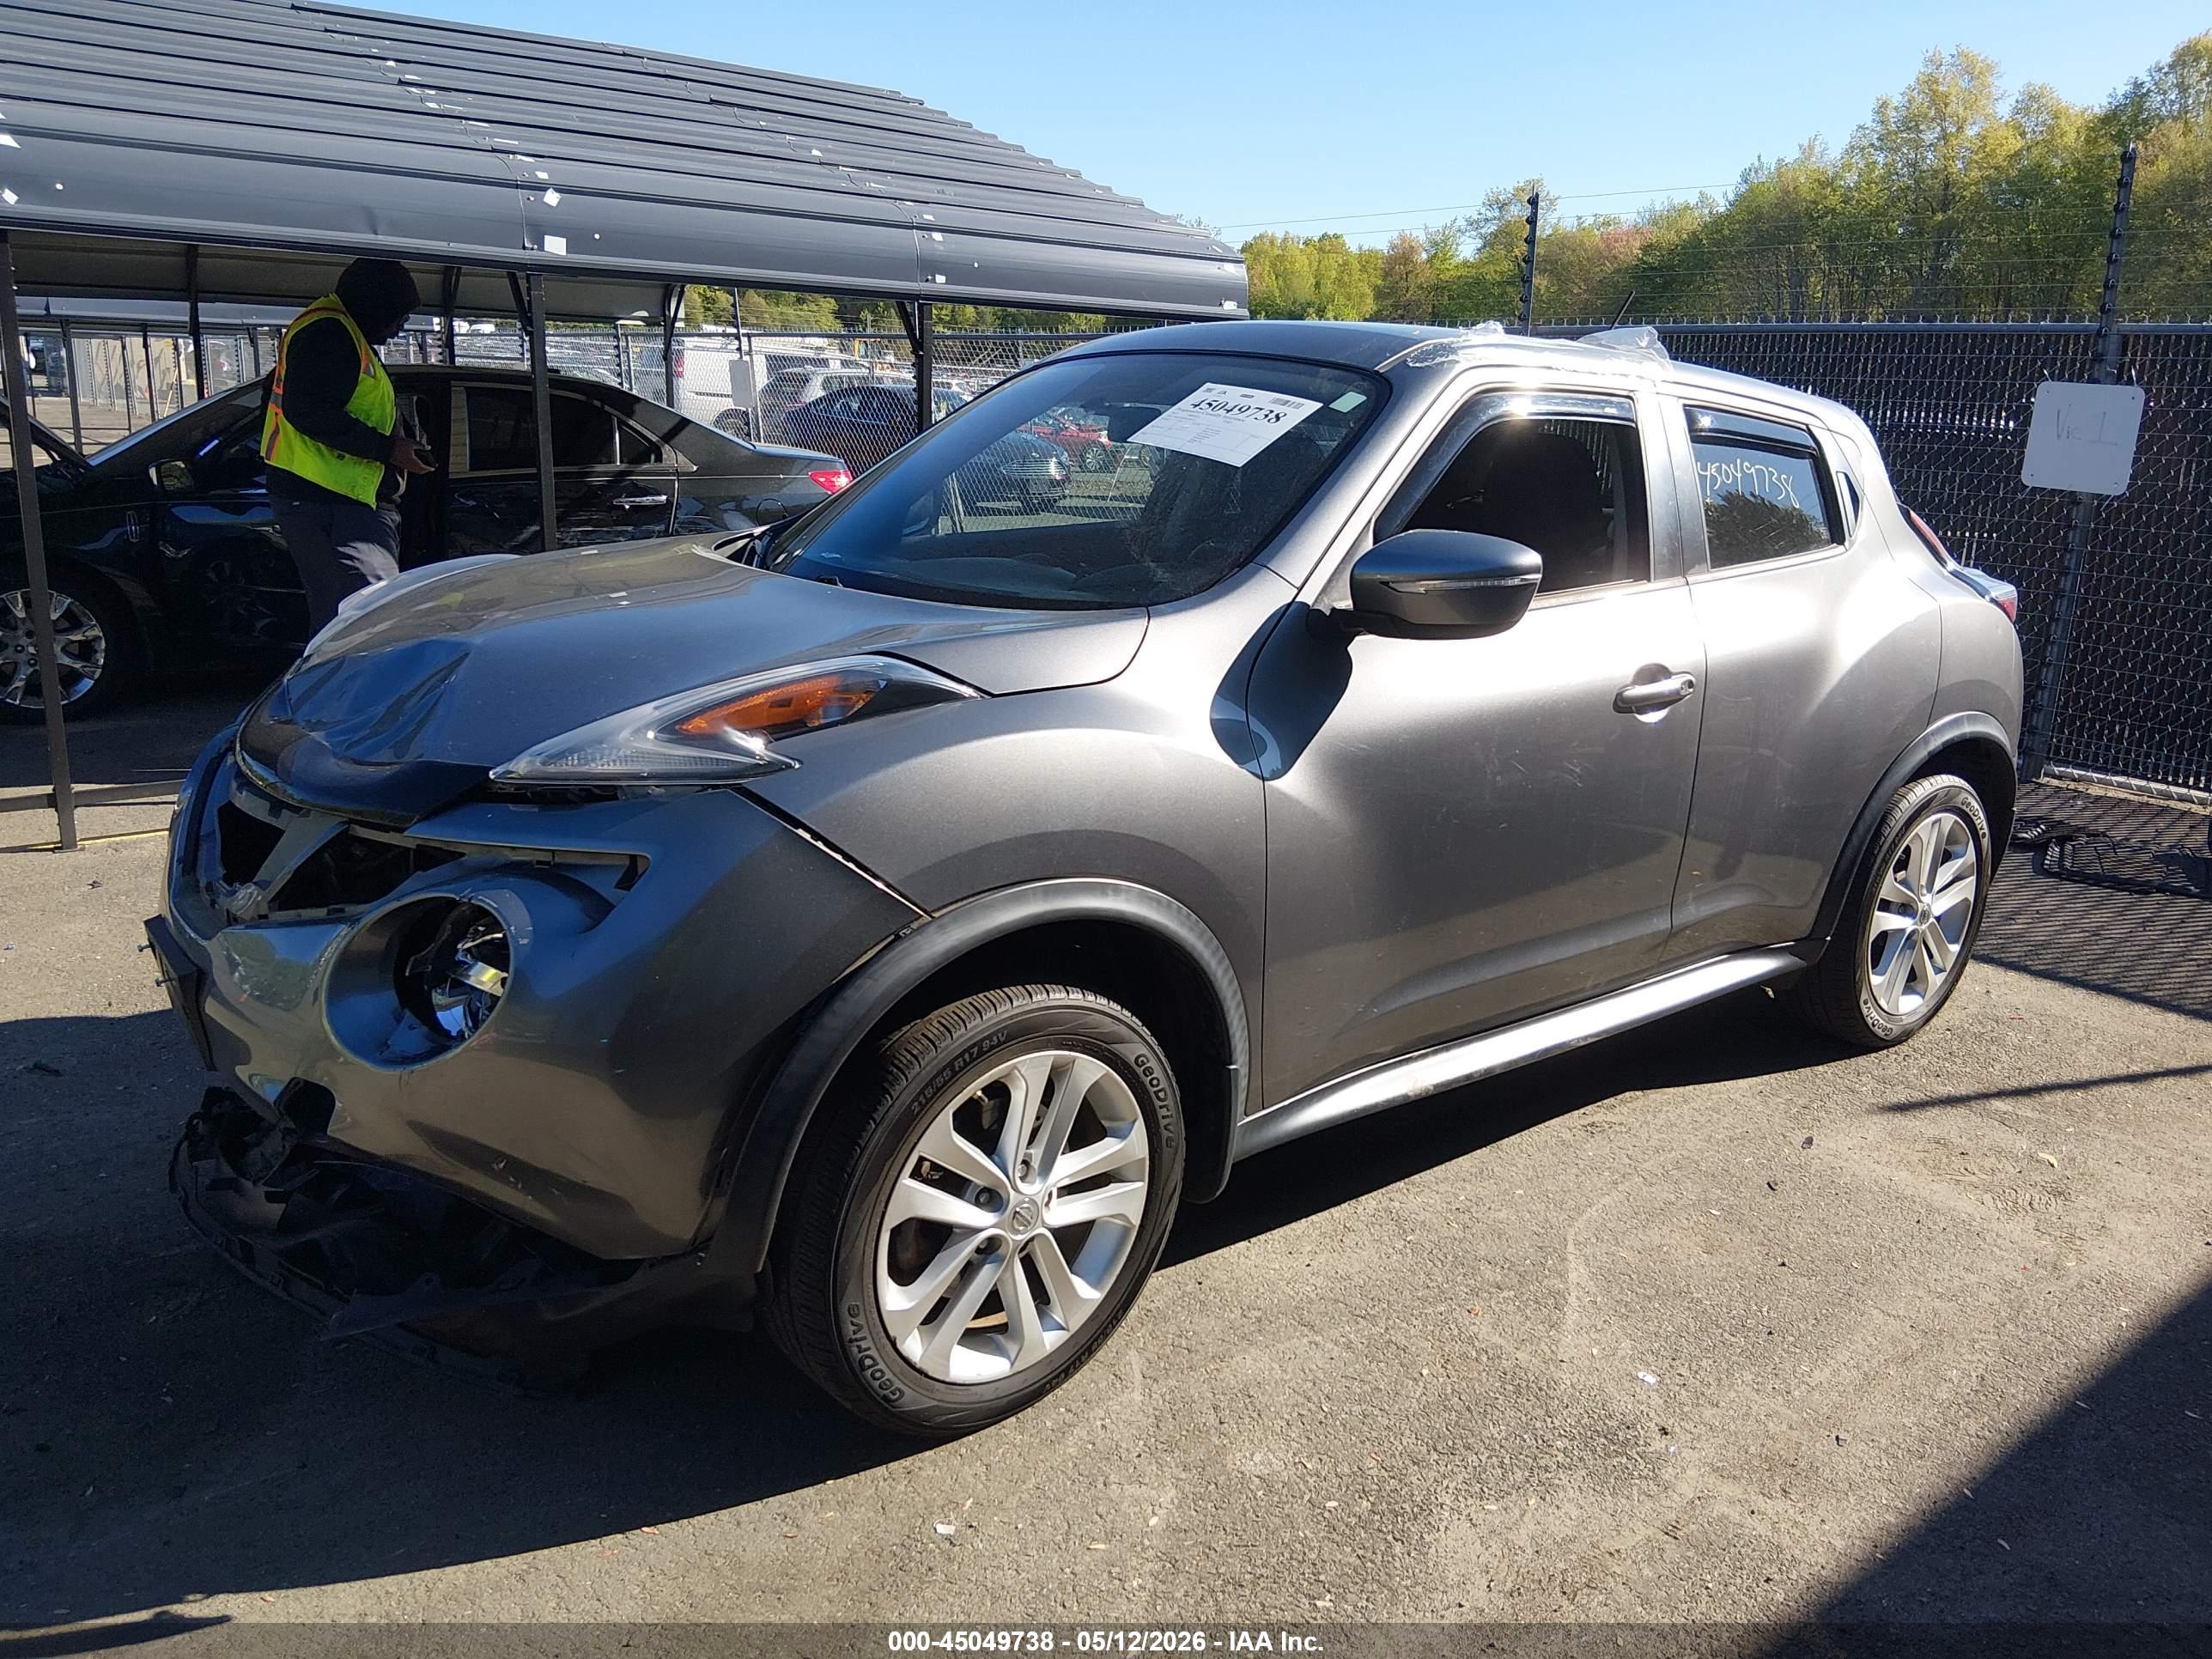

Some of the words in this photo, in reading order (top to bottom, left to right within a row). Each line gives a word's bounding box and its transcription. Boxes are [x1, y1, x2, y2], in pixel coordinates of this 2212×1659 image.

[1189, 398, 1288, 425] 45049738
[1697, 459, 1800, 508] 45049738
[1960, 796, 1987, 840] GeoDrive
[1863, 997, 1893, 1036] GeoDrive
[1133, 1053, 1175, 1149] GeoDrive
[847, 1302, 906, 1403] GeoDrive
